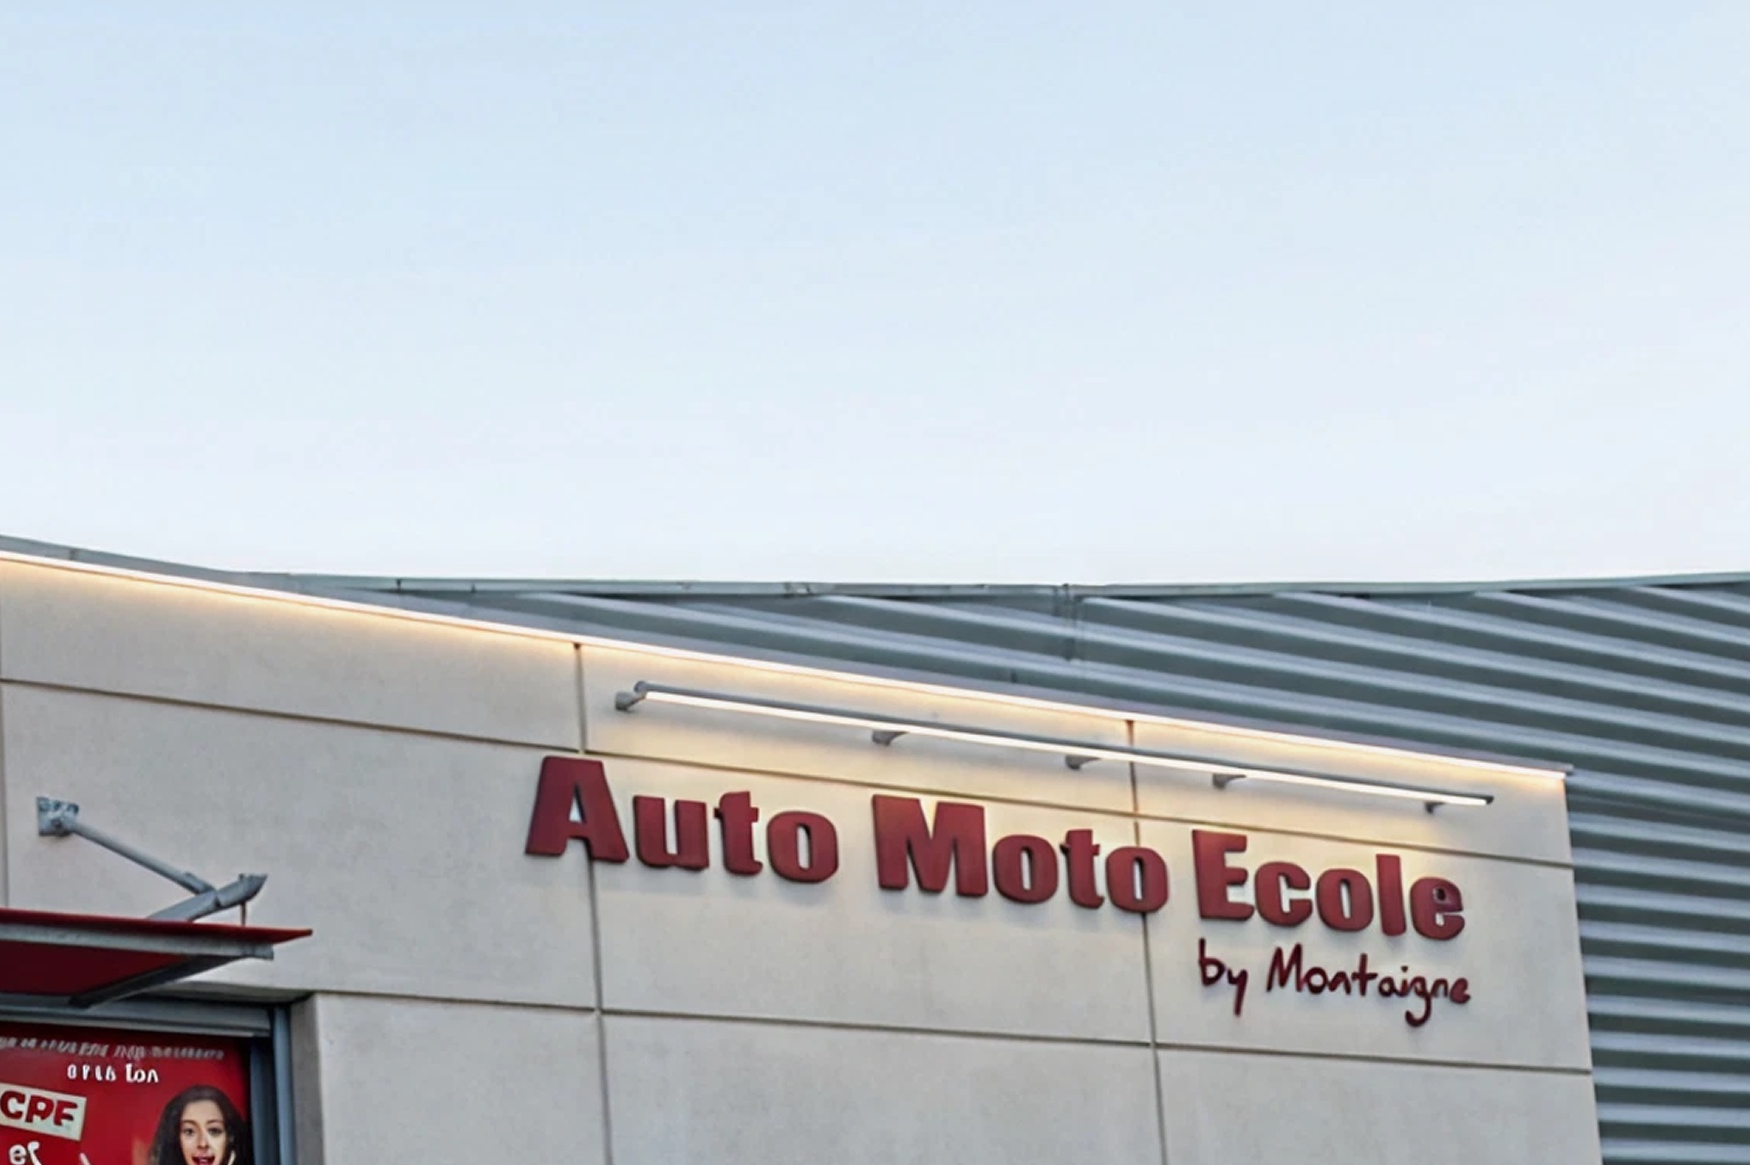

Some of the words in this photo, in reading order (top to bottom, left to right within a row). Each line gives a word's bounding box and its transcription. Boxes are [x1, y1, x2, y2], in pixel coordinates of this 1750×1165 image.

[525, 755, 840, 884] Auto
[871, 793, 1170, 914] Moto
[1191, 828, 1466, 941] Ecole
[1198, 938, 1249, 1016] by
[1265, 943, 1472, 1028] Montaigne
